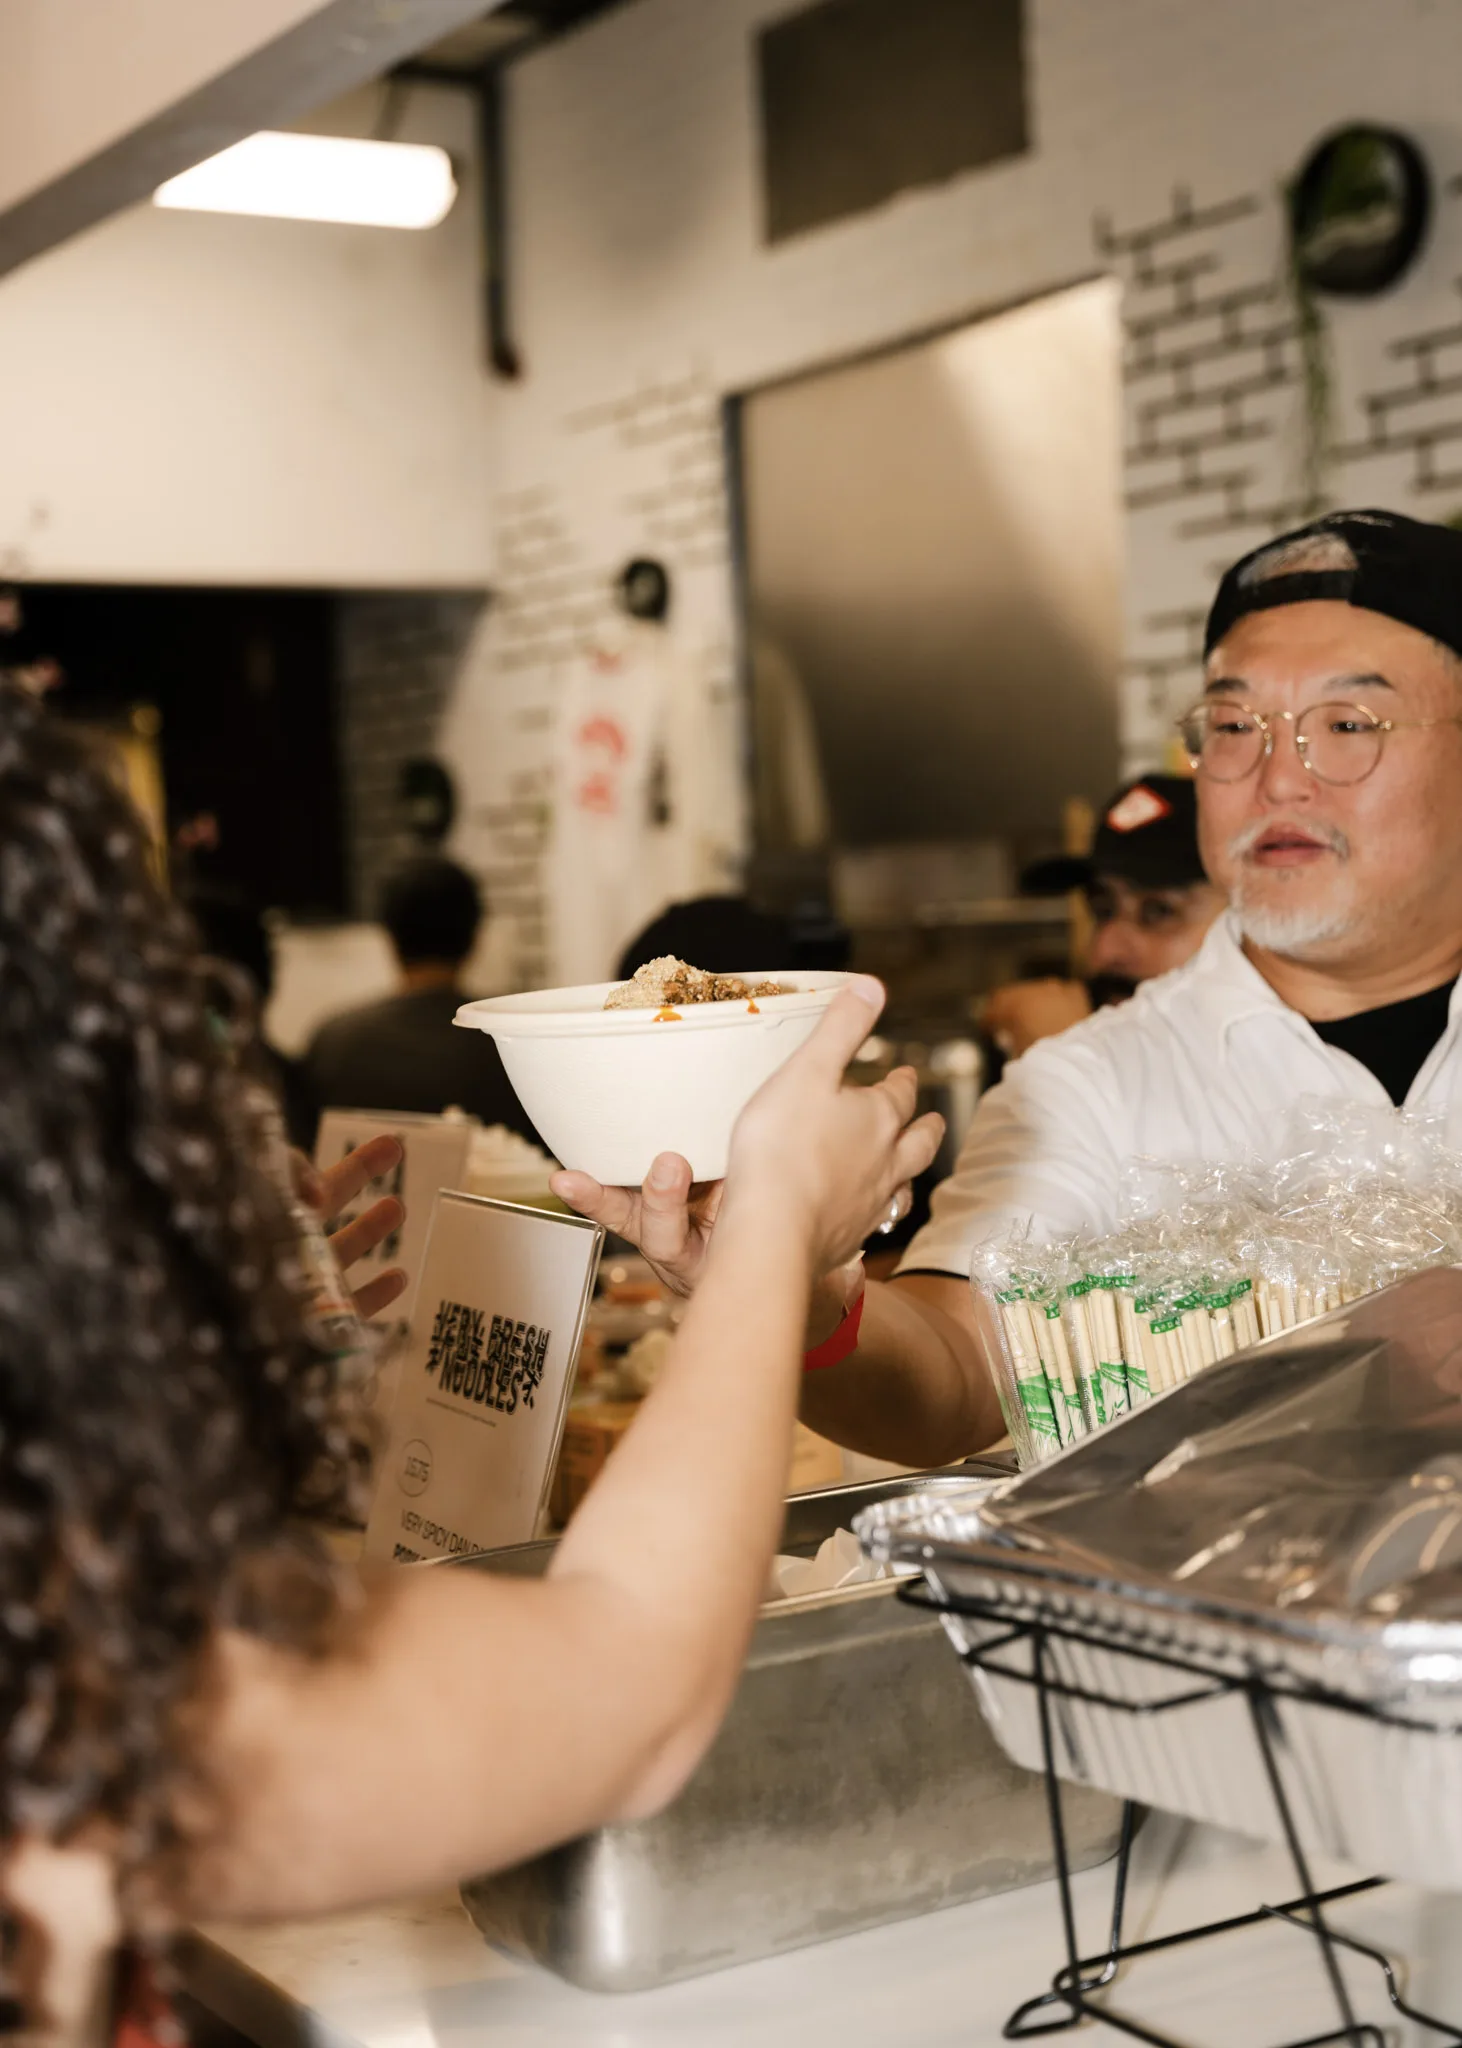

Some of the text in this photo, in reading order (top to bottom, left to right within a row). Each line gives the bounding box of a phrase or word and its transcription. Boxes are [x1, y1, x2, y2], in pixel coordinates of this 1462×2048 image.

[434, 1299, 552, 1379] VERY FRESH
[438, 1348, 522, 1415] NOODLES
[401, 1508, 422, 1535] VERY
[421, 1519, 450, 1549] SPICY
